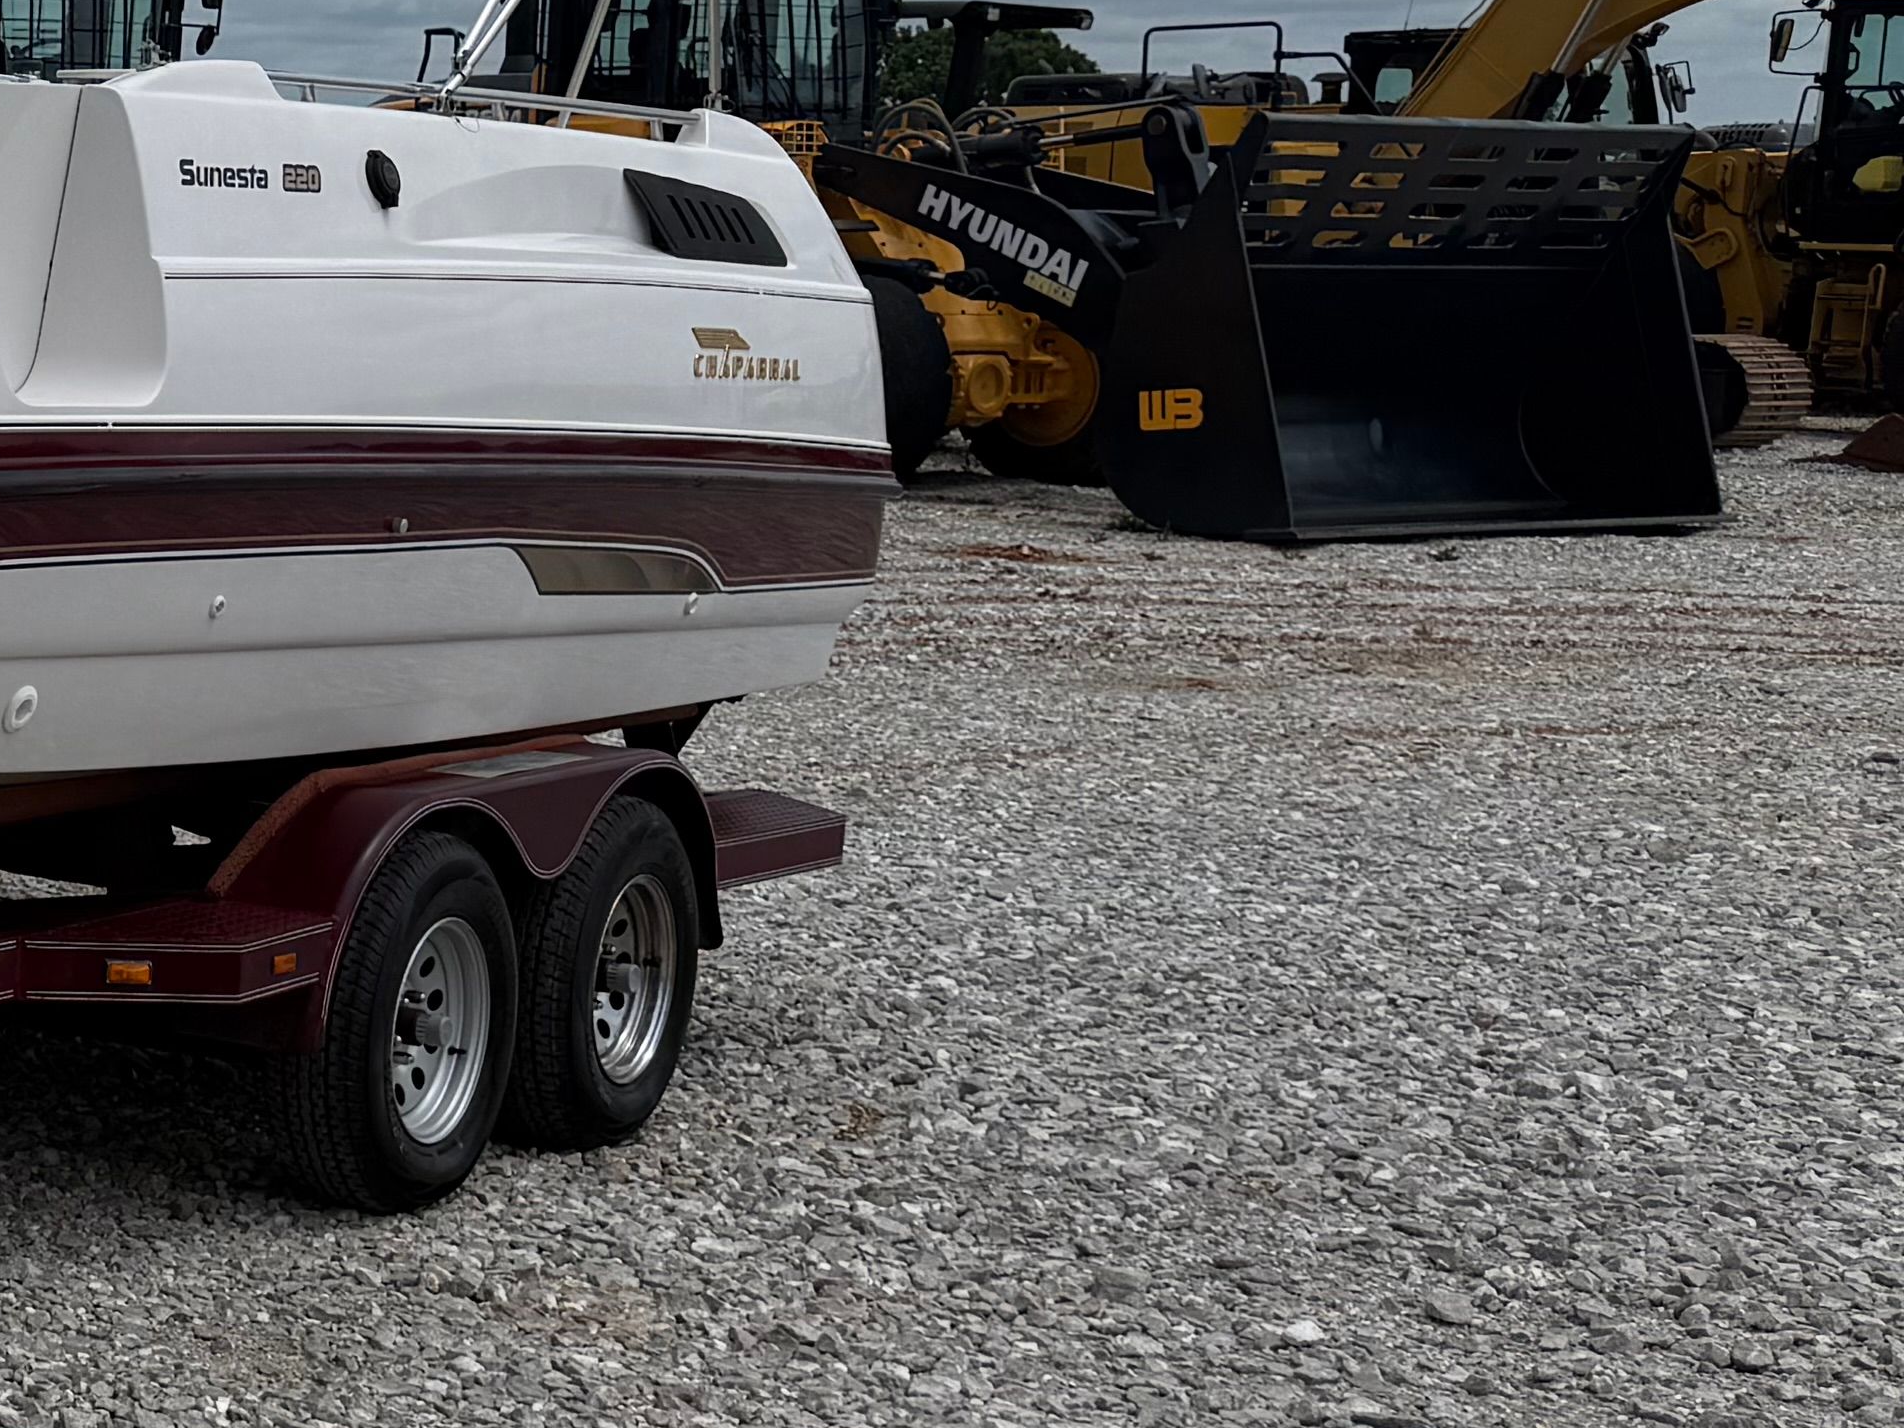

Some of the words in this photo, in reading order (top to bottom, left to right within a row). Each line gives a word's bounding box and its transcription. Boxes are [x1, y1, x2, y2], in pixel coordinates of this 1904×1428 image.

[179, 159, 268, 189] Sunesta
[282, 163, 322, 193] 220
[917, 183, 1090, 292] HYUNDAI
[693, 351, 801, 382] CHAPARRAL
